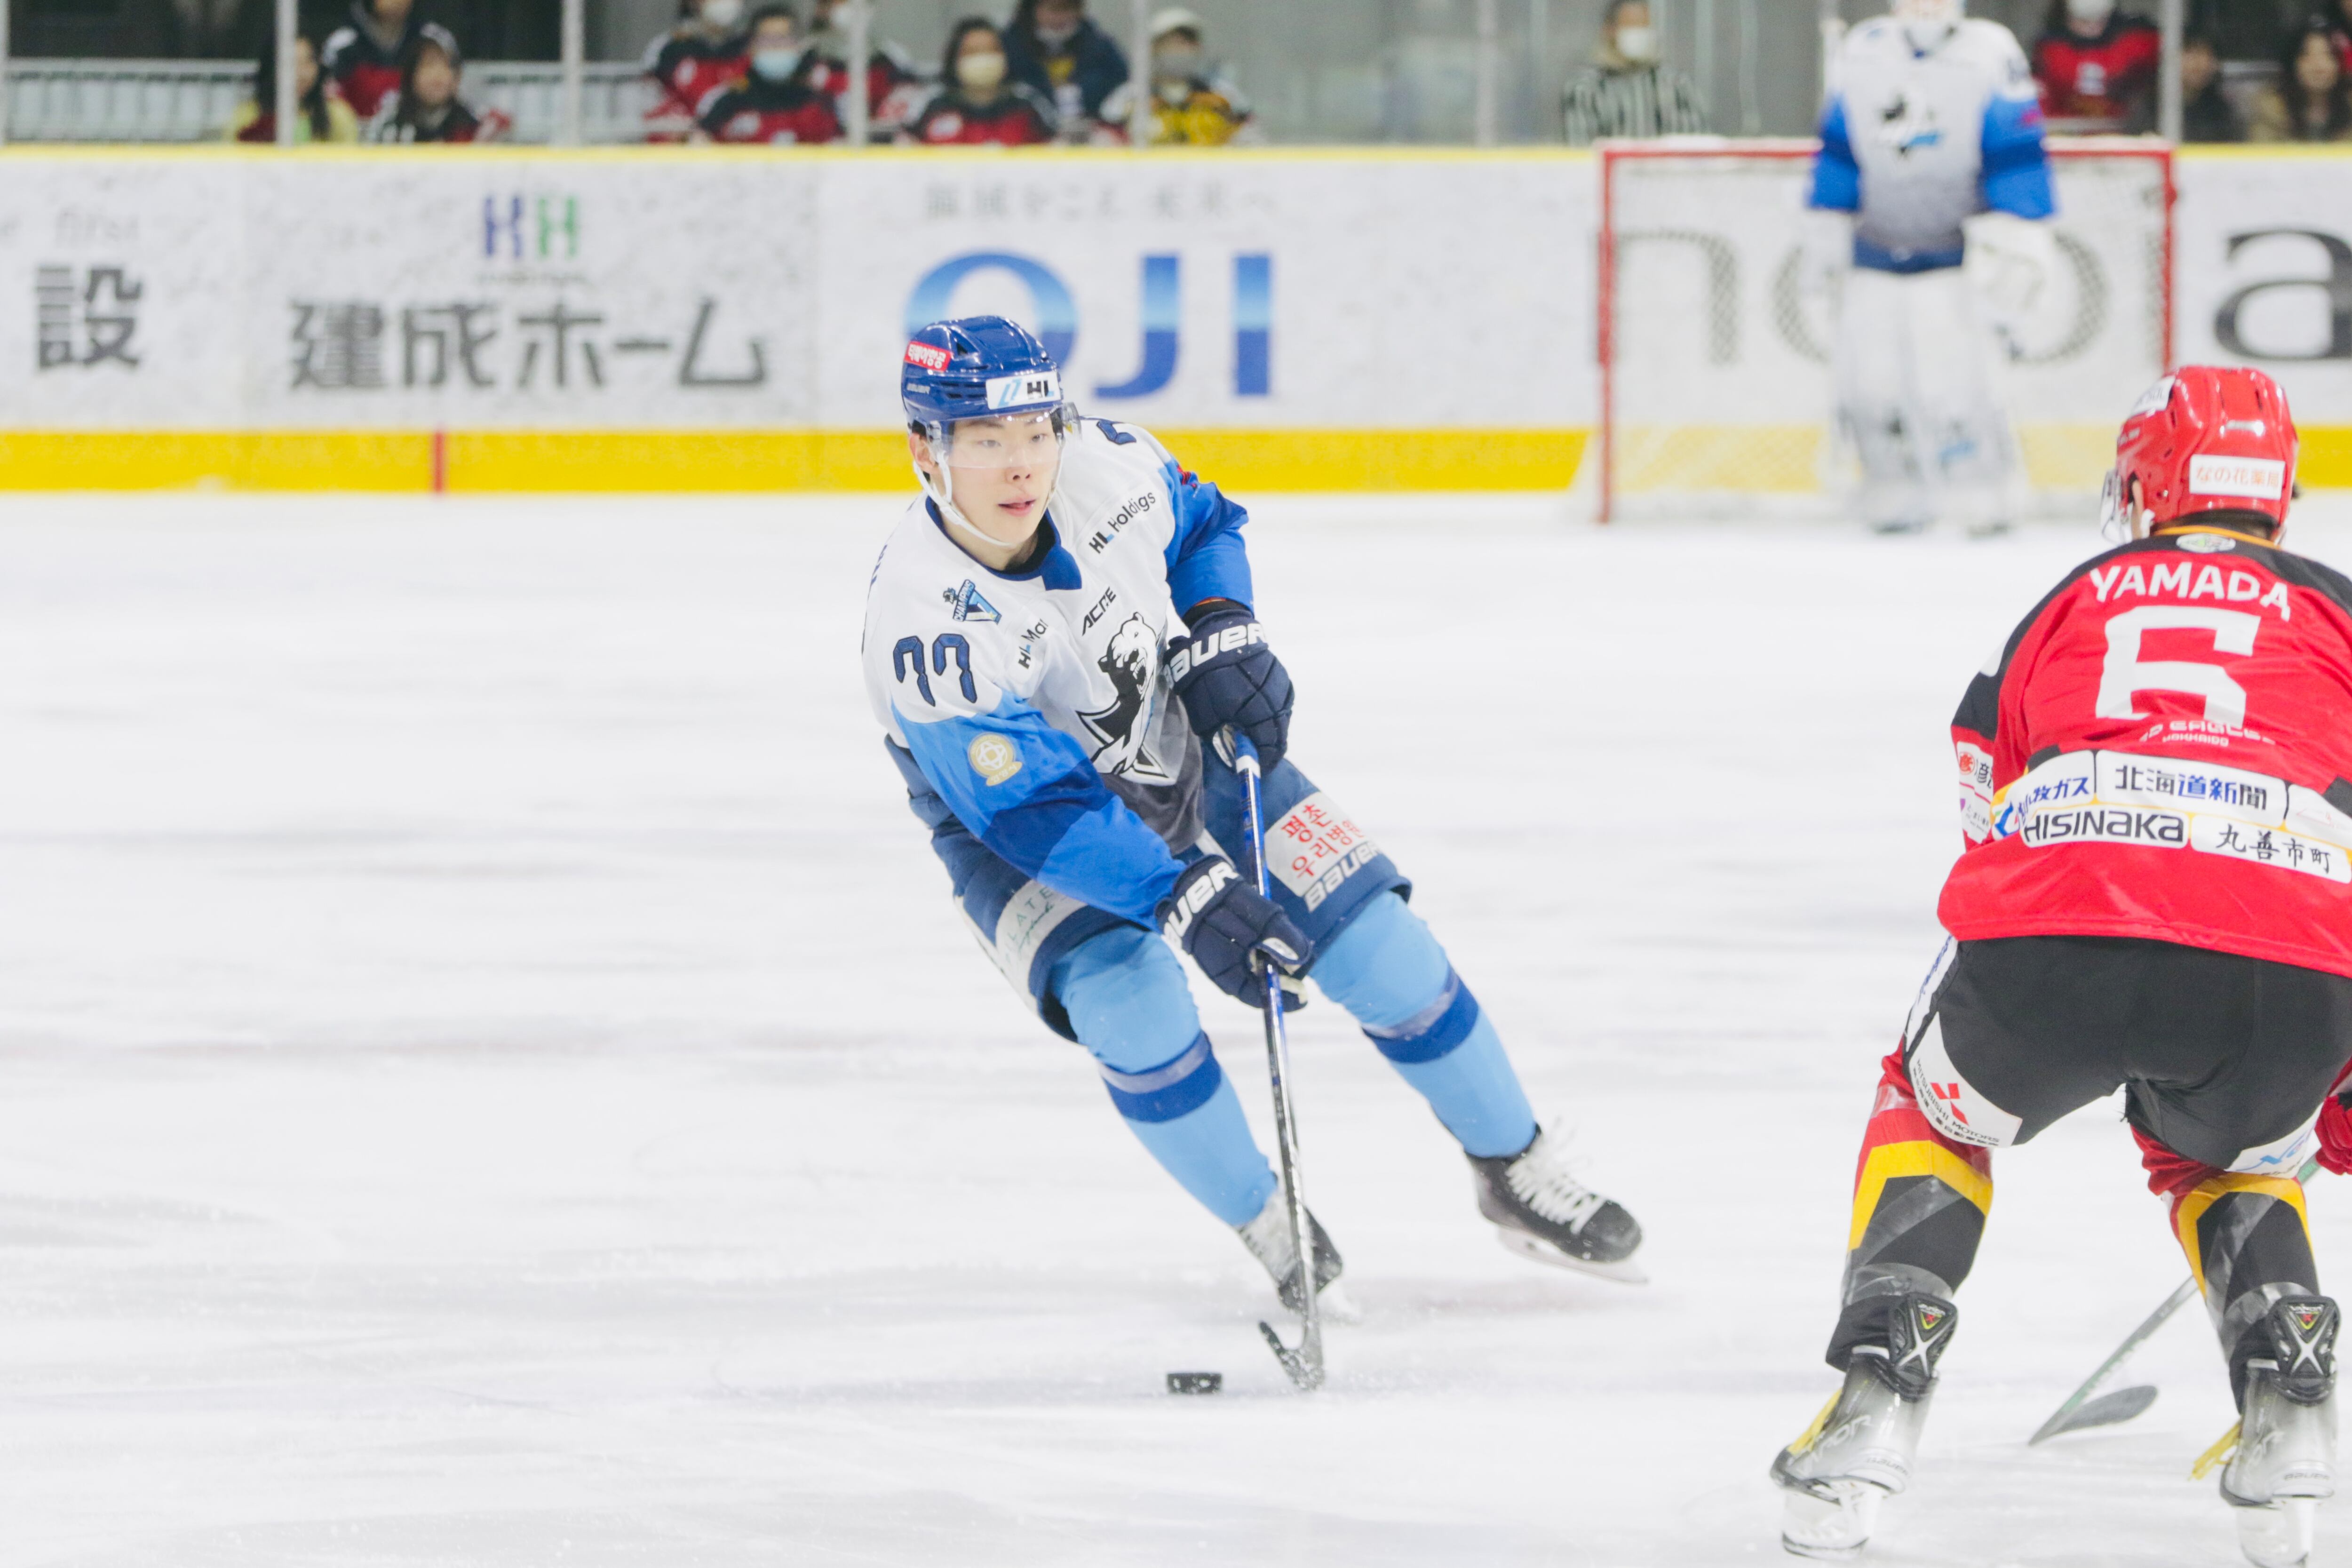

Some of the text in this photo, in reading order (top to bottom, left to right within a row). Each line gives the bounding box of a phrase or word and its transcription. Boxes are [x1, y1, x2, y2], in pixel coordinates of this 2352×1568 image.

[35, 265, 143, 370] 設
[289, 298, 769, 390] 建成ホーム
[903, 251, 1271, 400] OJI
[908, 343, 946, 369] 티웨이항공
[1027, 380, 1054, 399] HL
[2196, 466, 2280, 488] なの花薬局
[1089, 531, 1114, 554] HL
[2090, 562, 2291, 622] YAMADA
[2095, 605, 2261, 729] 6
[2115, 765, 2267, 811] 北海道新聞
[1280, 804, 1334, 843] 평촌
[1291, 820, 1365, 879] 우리병원
[2216, 823, 2331, 874] 丸善市町
[1917, 1059, 2000, 1143] MITSUBISHI MOTORS
